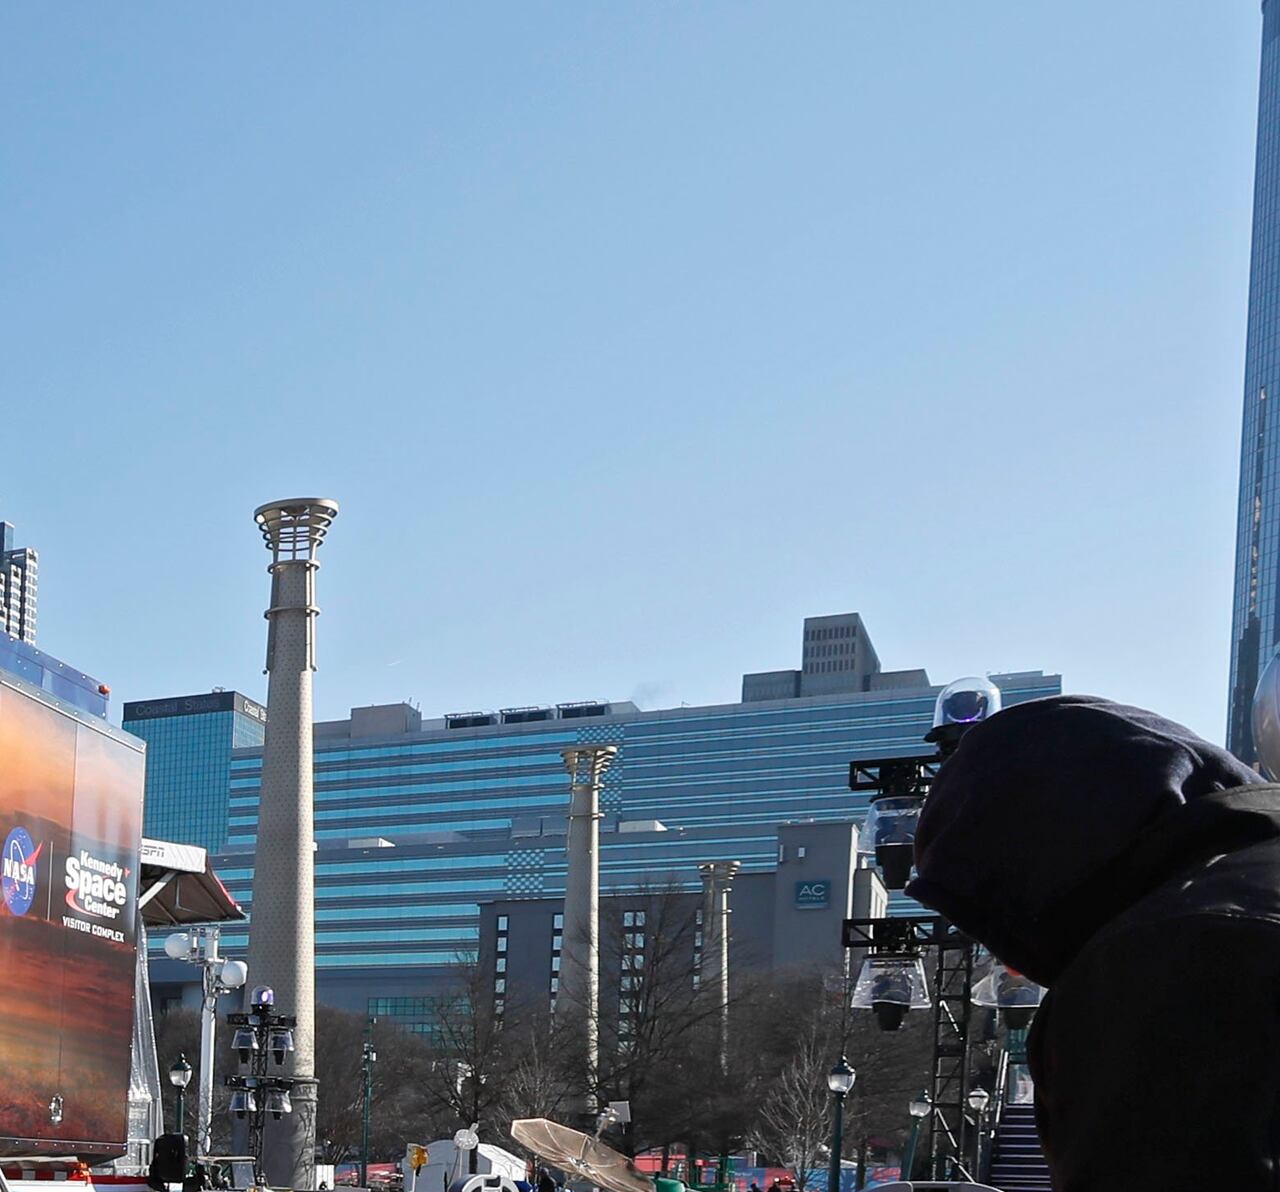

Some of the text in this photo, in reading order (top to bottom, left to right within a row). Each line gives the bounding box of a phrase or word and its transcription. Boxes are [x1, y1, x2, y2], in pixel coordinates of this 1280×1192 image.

[3, 857, 35, 885] NASA
[80, 850, 123, 882] Kennedy
[65, 856, 127, 906] Space
[799, 884, 825, 896] AC
[84, 895, 120, 919] Center
[62, 916, 125, 943] VISITOR COMPLEX
